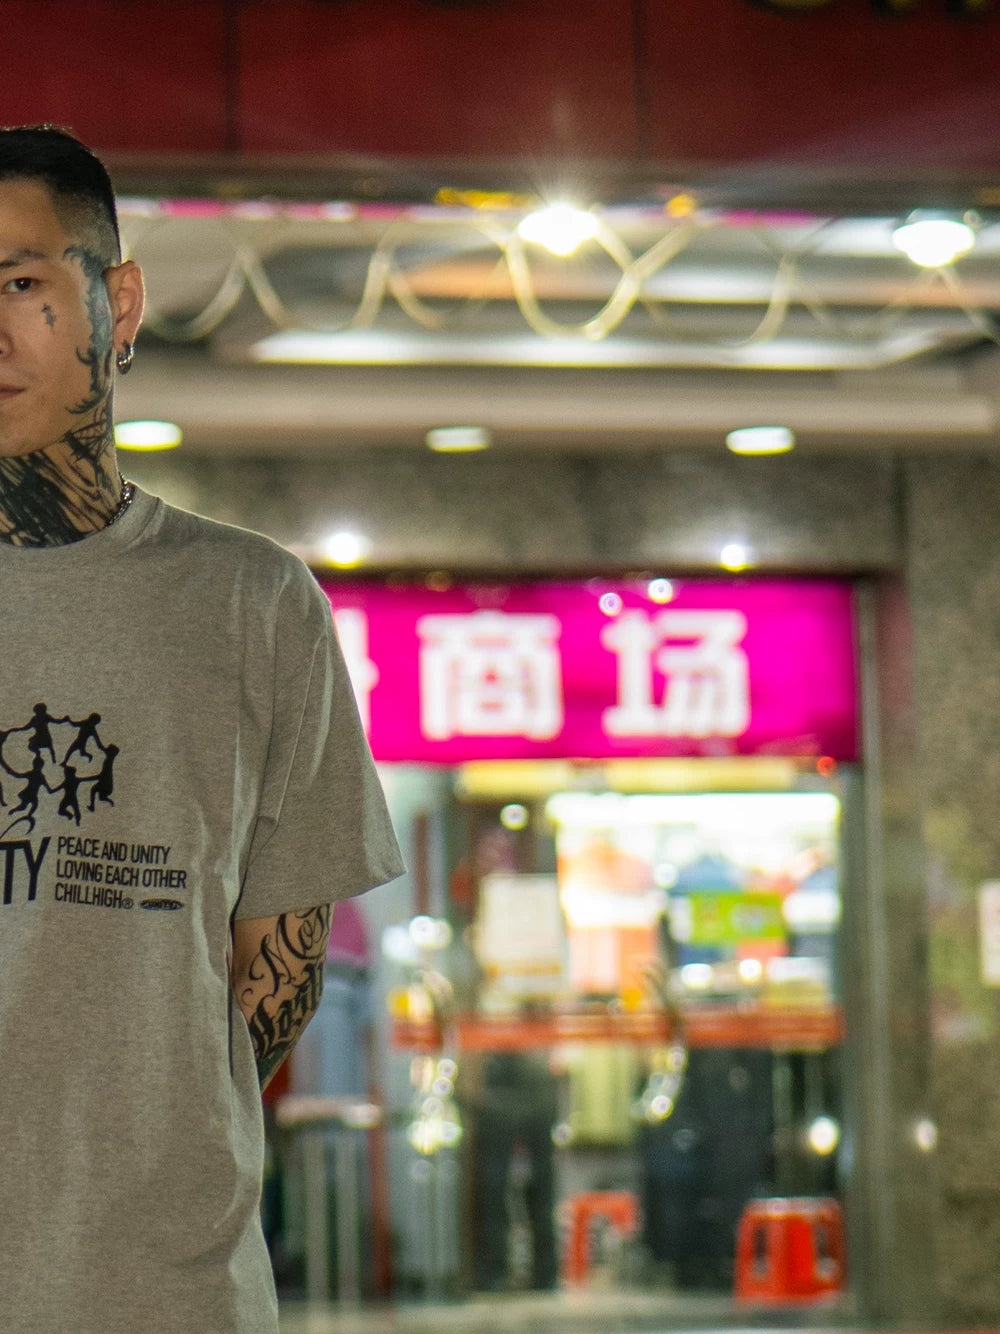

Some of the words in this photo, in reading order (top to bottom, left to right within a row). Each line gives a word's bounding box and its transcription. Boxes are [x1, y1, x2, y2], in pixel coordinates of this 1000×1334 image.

[57, 836, 100, 859] PEACE
[101, 841, 128, 862] AND
[131, 844, 171, 865] UNITY
[56, 859, 103, 883] LOVING
[105, 865, 140, 887] EACH
[142, 868, 187, 889] OTHER
